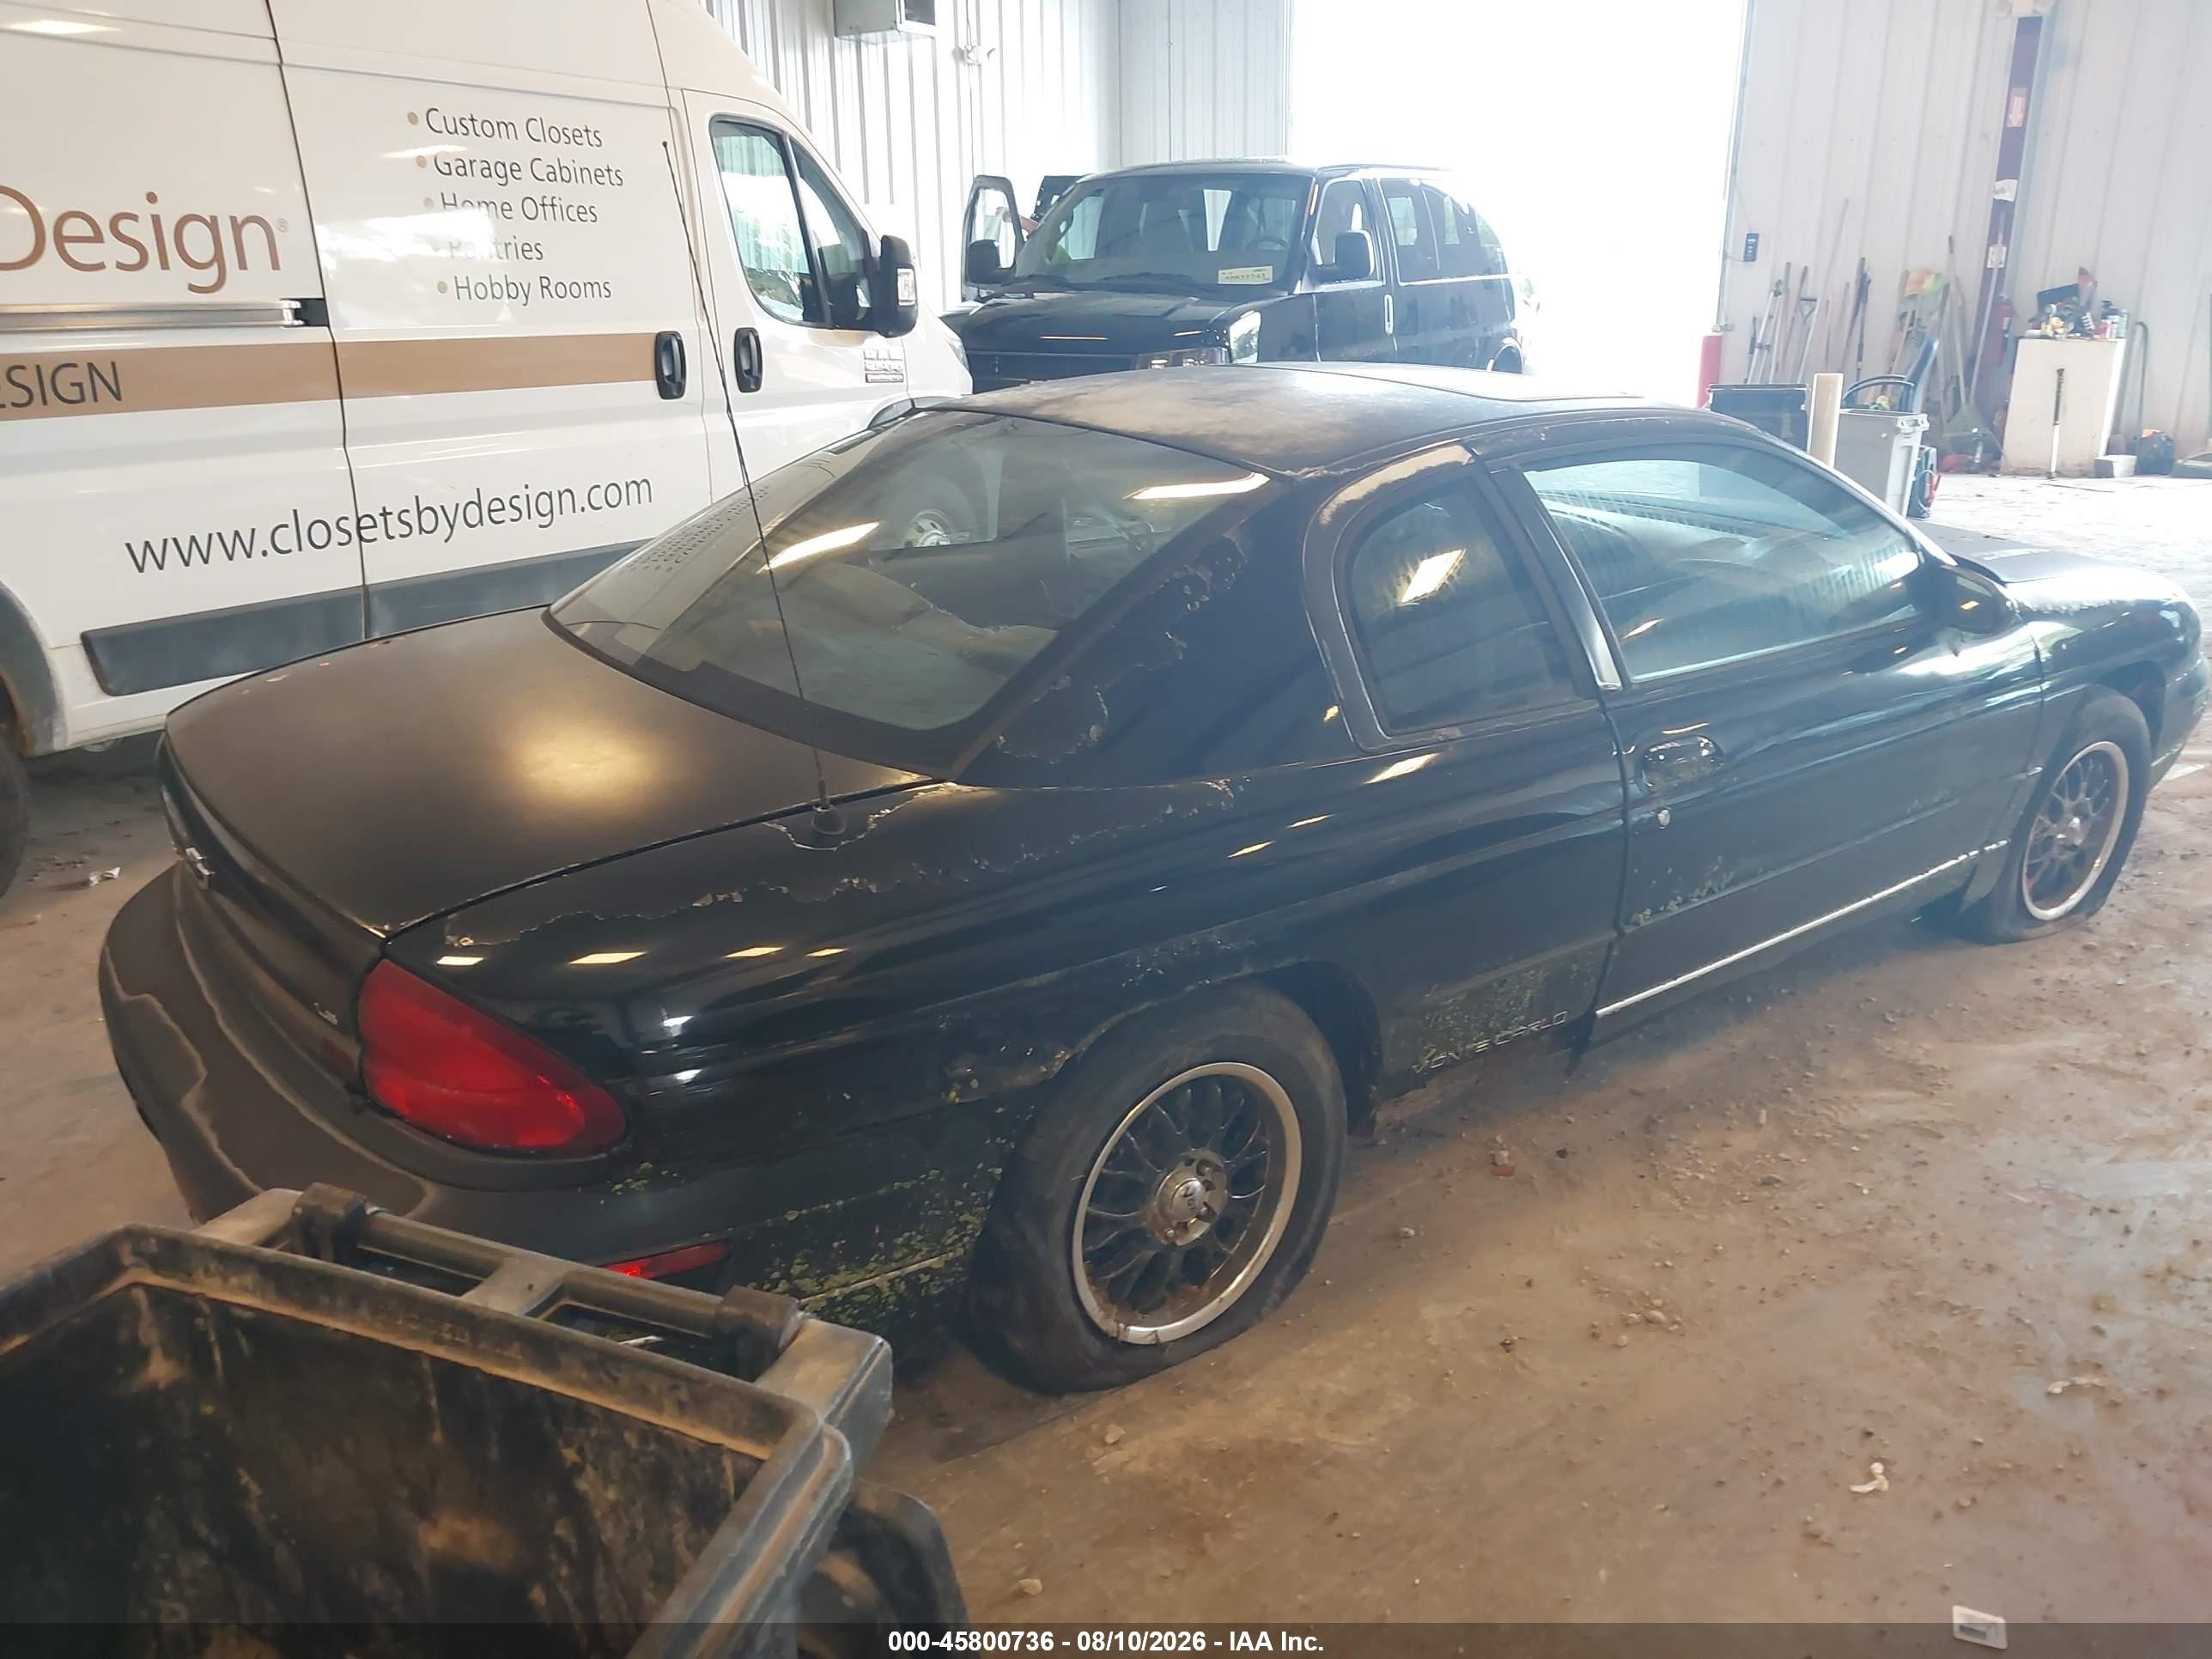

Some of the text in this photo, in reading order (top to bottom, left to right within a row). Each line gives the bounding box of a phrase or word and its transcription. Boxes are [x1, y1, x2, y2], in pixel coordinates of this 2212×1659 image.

[426, 107, 603, 148] Custom Closets
[434, 152, 624, 187] Garage Cabinets
[520, 196, 599, 223] Offices
[448, 234, 544, 261] Ptries
[454, 274, 611, 307] Hobby Rooms
[0, 361, 123, 410] SIGN
[125, 477, 653, 574] www.closetsbydesign.com
